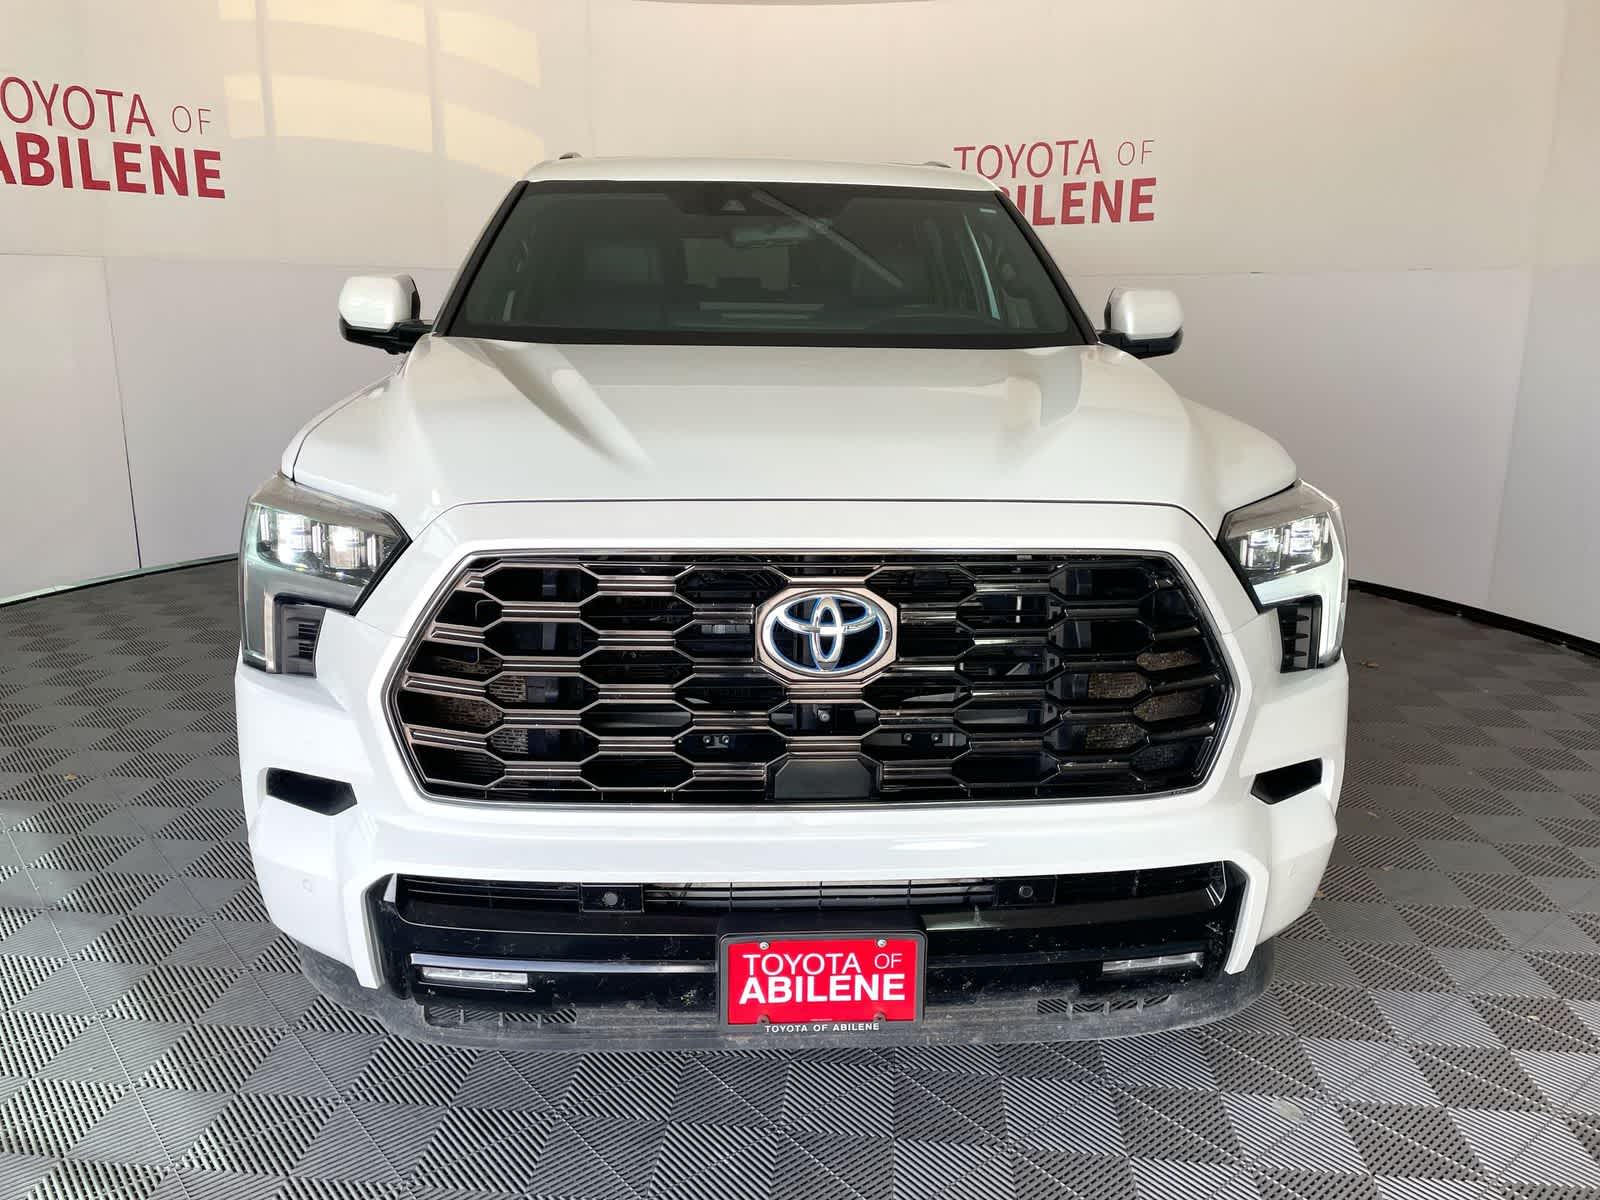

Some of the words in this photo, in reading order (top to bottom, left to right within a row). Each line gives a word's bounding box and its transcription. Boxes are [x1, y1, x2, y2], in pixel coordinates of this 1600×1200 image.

[0, 76, 155, 136] OYOTA
[172, 105, 212, 134] OF
[953, 139, 1101, 180] TOYOTA
[1117, 140, 1155, 166] OF
[1000, 177, 1157, 226] ILENE
[742, 953, 861, 976] TOYOTA
[874, 953, 903, 969] OF
[739, 973, 905, 1004] ABILENE
[765, 1024, 808, 1033] TOYOTA
[813, 1024, 828, 1032] OF
[832, 1023, 880, 1031] ABILENE
